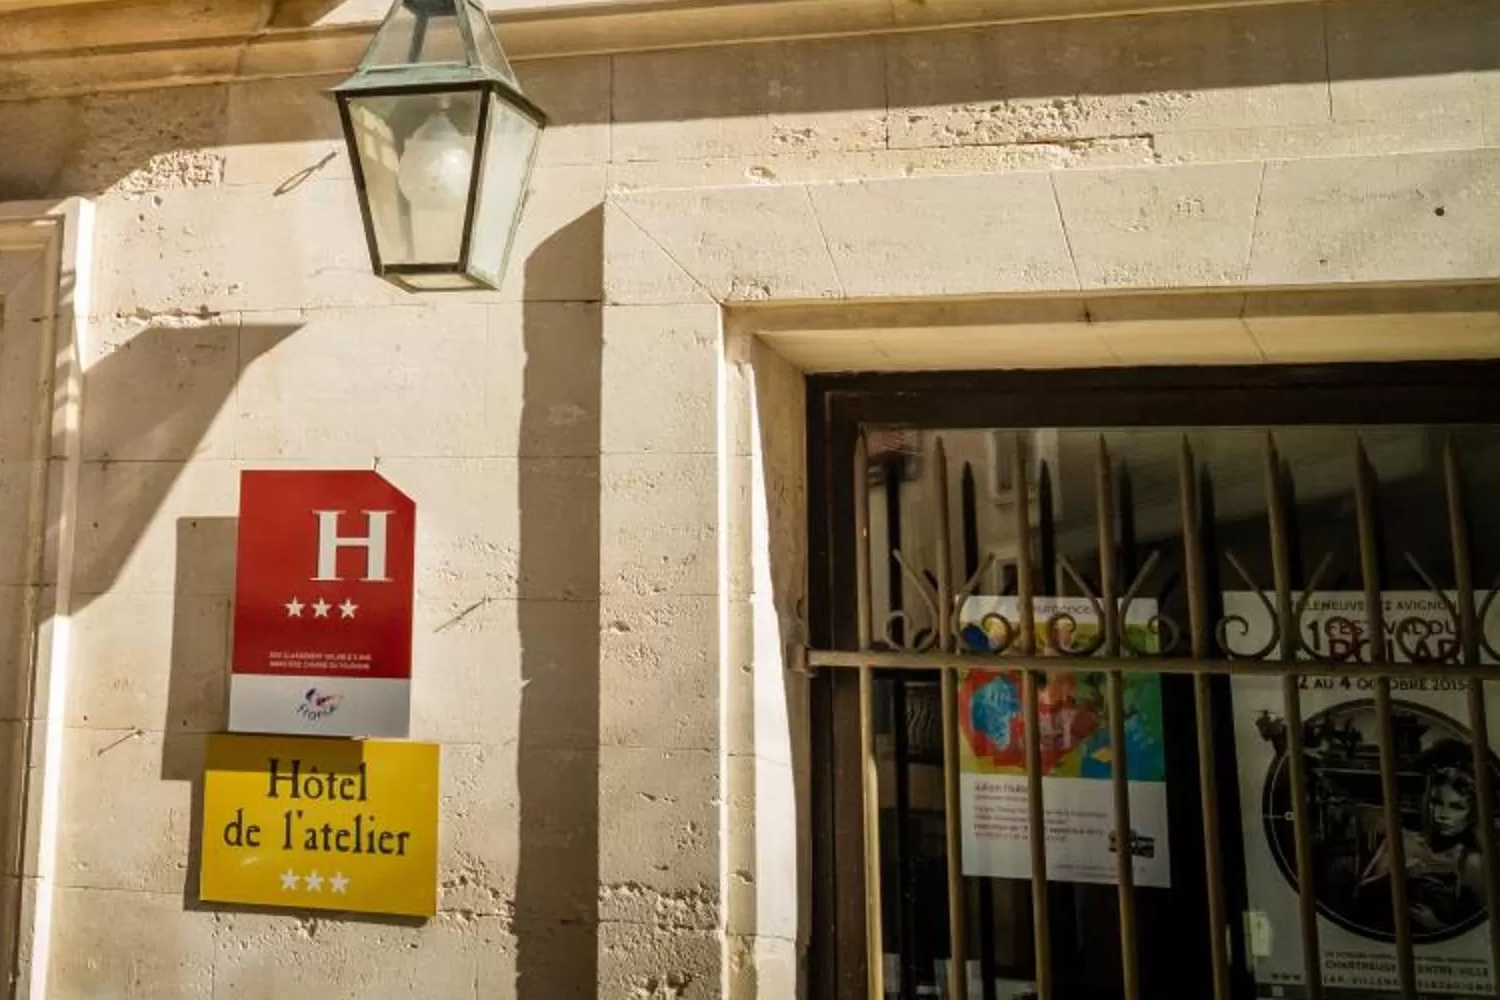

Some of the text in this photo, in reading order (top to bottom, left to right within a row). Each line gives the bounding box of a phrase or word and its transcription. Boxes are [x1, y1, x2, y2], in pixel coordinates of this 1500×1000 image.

[310, 509, 396, 582] H
[1357, 679, 1430, 692] OCOBRE
[267, 758, 368, 802] Hôtel
[223, 809, 411, 857] de l'atelier
